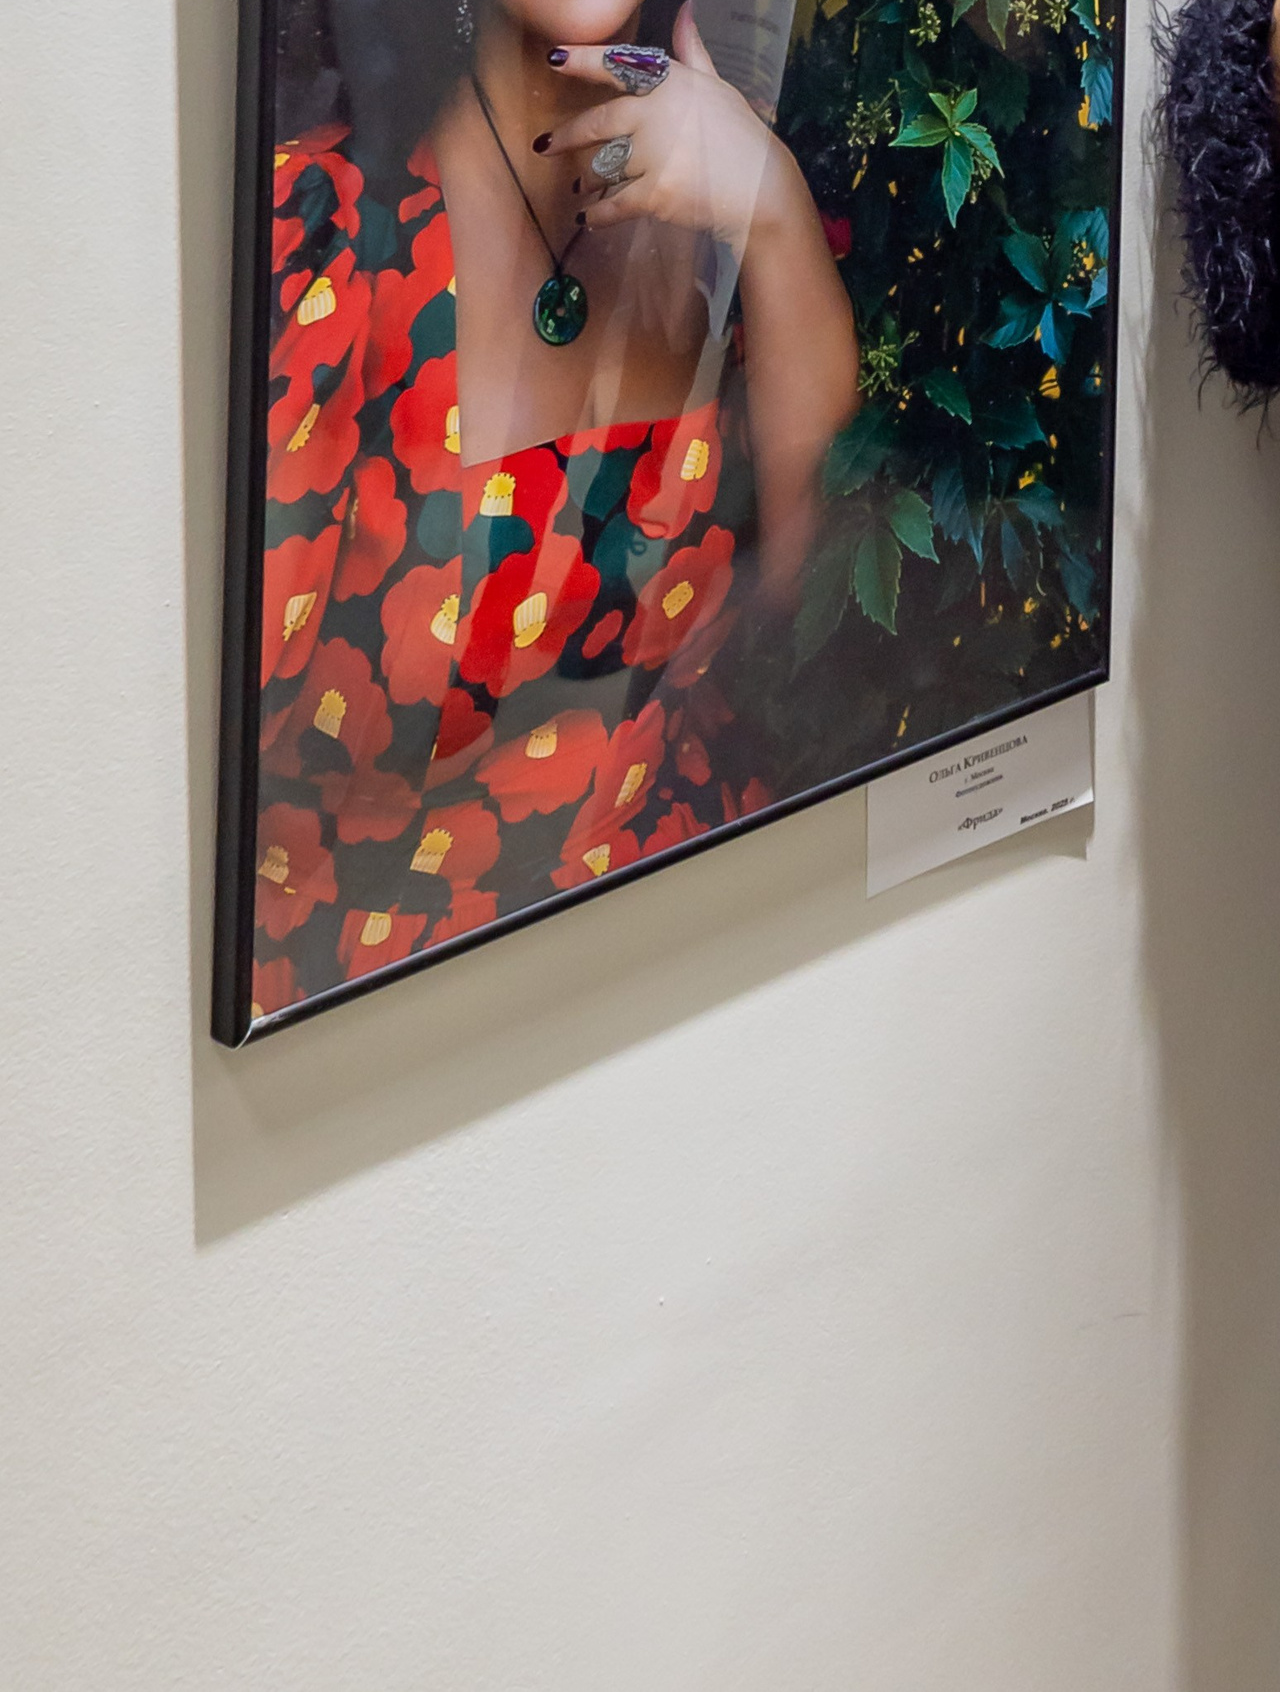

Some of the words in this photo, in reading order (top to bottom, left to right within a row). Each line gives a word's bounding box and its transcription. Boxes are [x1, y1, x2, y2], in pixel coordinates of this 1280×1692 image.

[929, 763, 961, 784] ОЛЬГА
[963, 735, 1028, 770] КРИВЕНЦОВА
[957, 807, 1003, 831] «Фрида»
